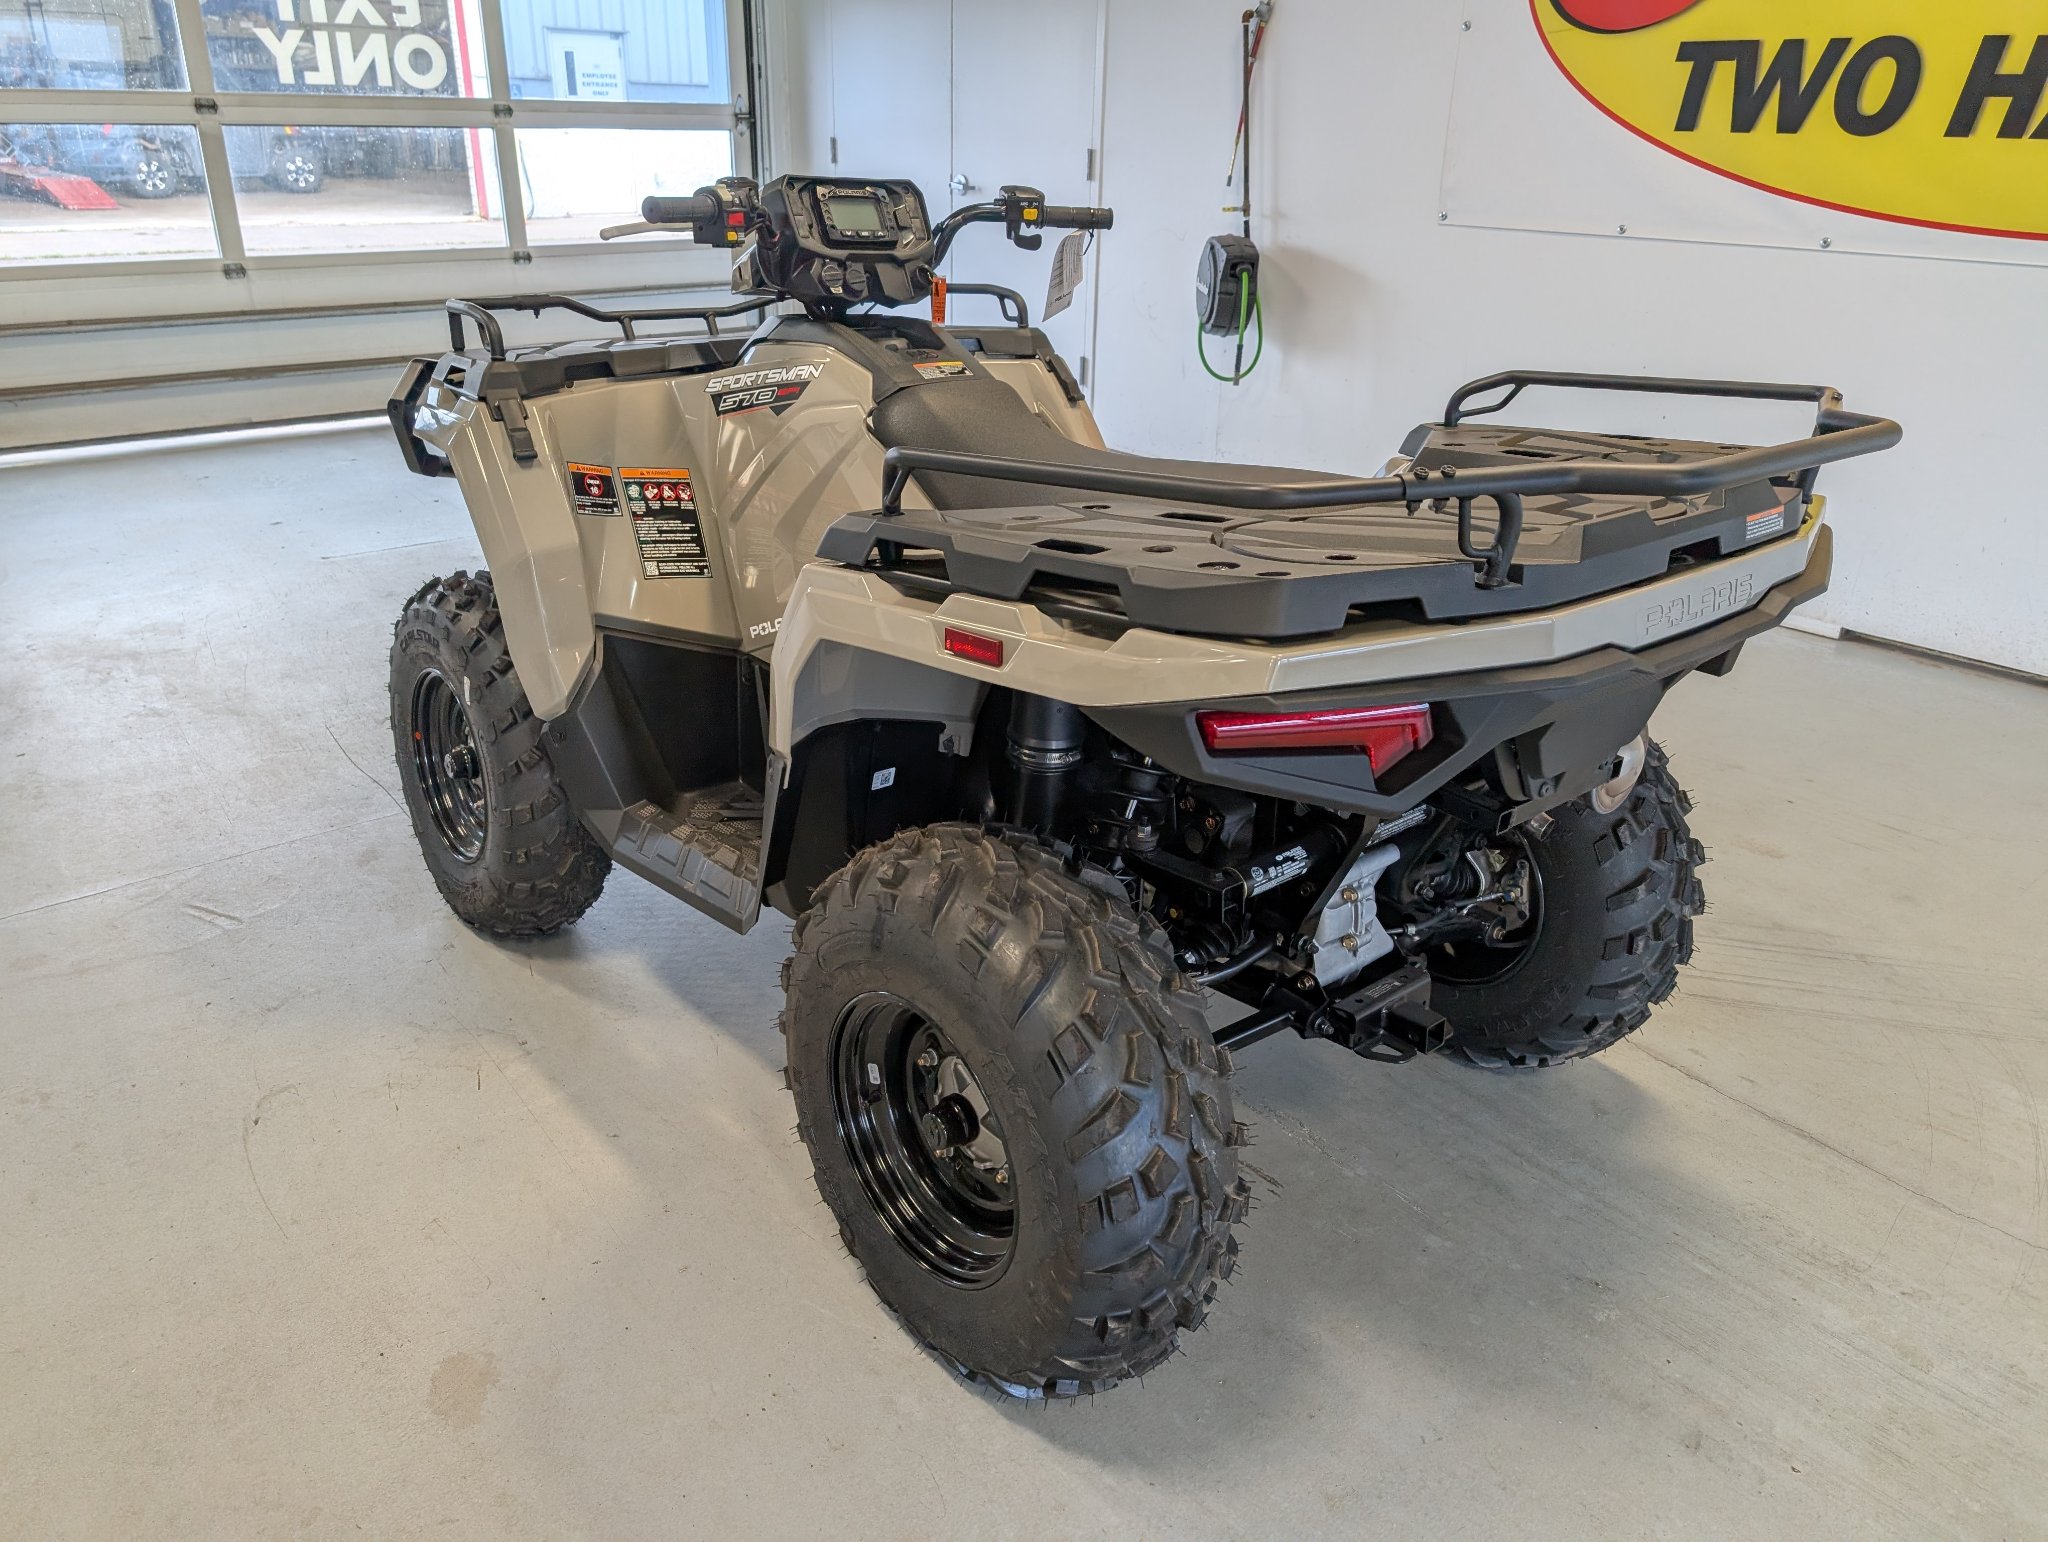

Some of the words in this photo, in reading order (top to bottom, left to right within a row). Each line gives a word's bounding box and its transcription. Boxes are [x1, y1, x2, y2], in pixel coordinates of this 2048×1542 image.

[1673, 35, 1922, 138] TWO
[1943, 34, 2048, 140] H
[705, 363, 825, 392] SPORTSMAN
[719, 387, 777, 411] 570
[1645, 573, 1753, 636] POLARIS
